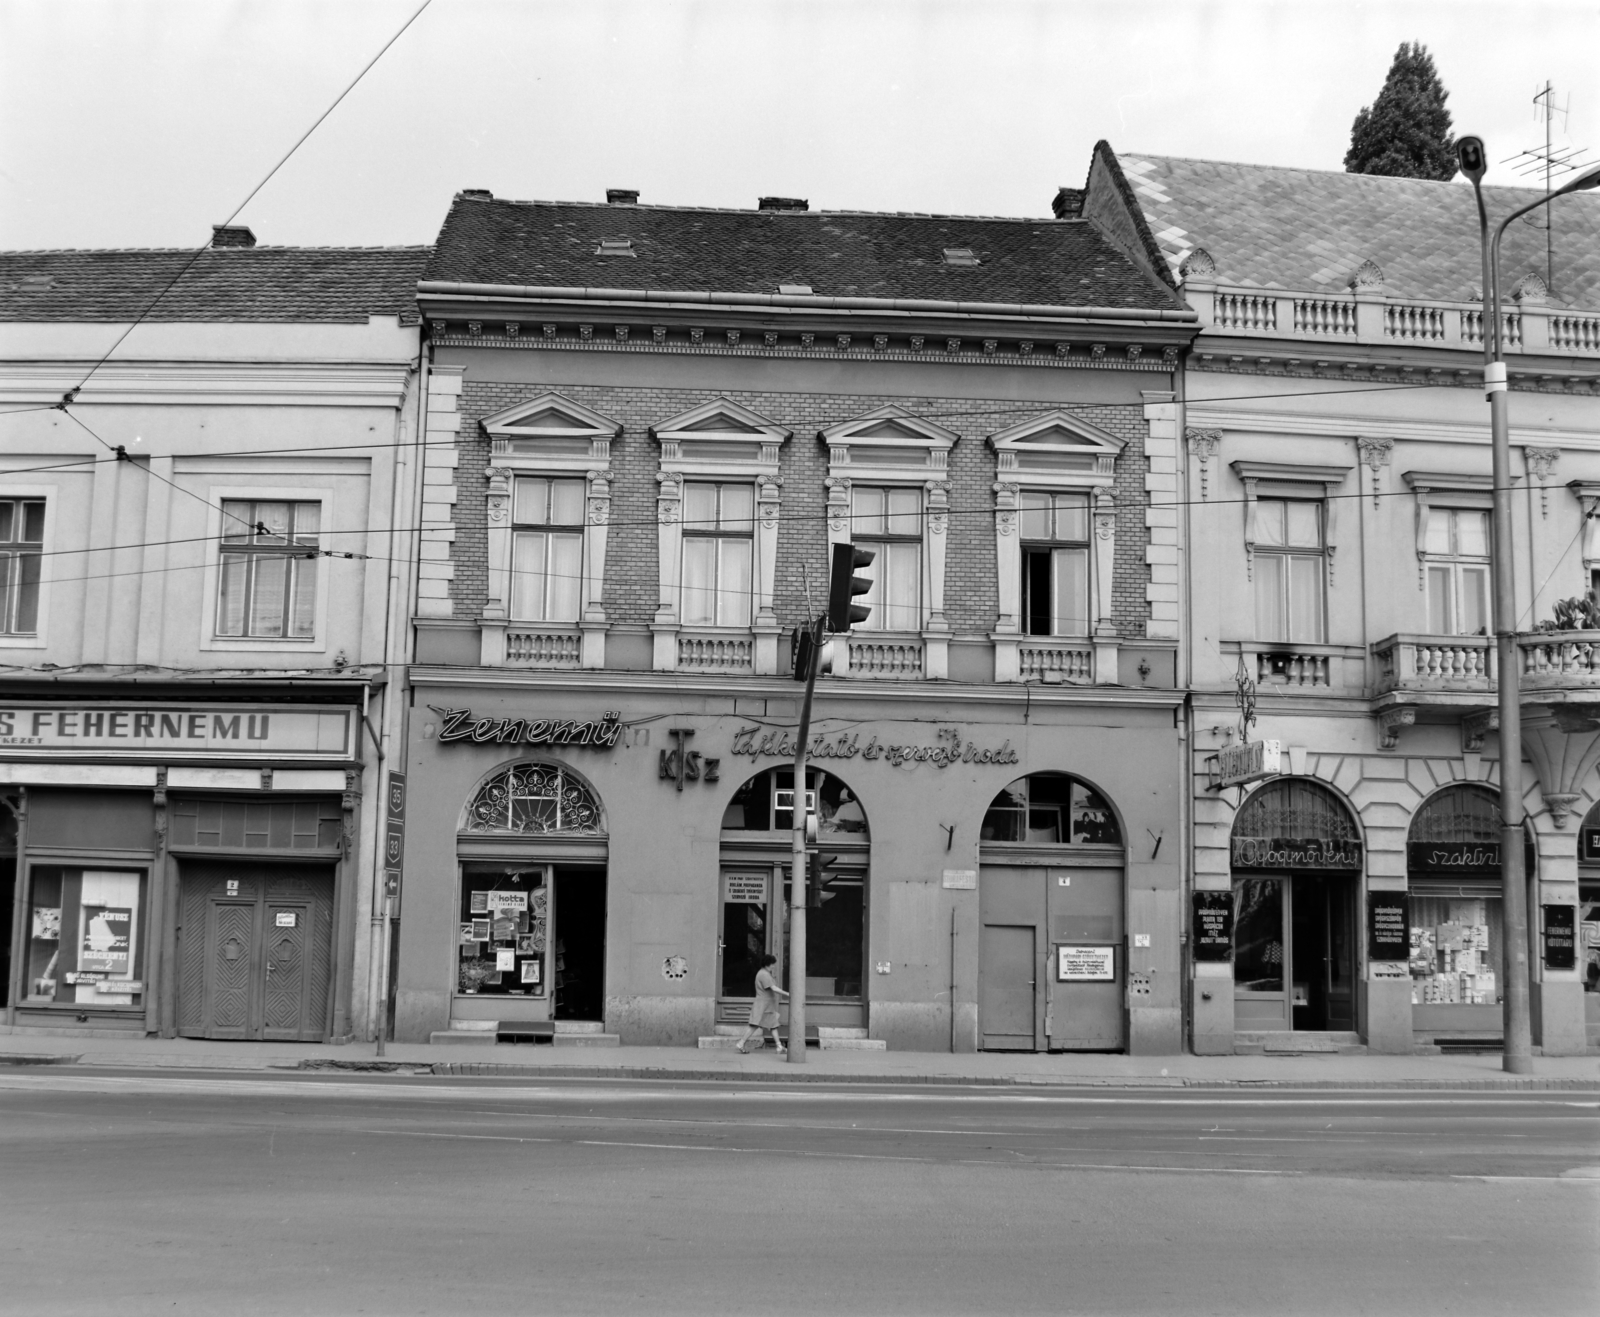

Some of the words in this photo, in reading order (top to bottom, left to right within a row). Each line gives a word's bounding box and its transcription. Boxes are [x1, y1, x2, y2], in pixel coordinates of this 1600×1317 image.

[0, 736, 44, 745] KEZET
[962, 739, 1019, 765] iroda
[392, 788, 402, 804] 35
[389, 840, 399, 855] 33
[498, 895, 525, 903] kotta
[105, 959, 113, 970] 2
